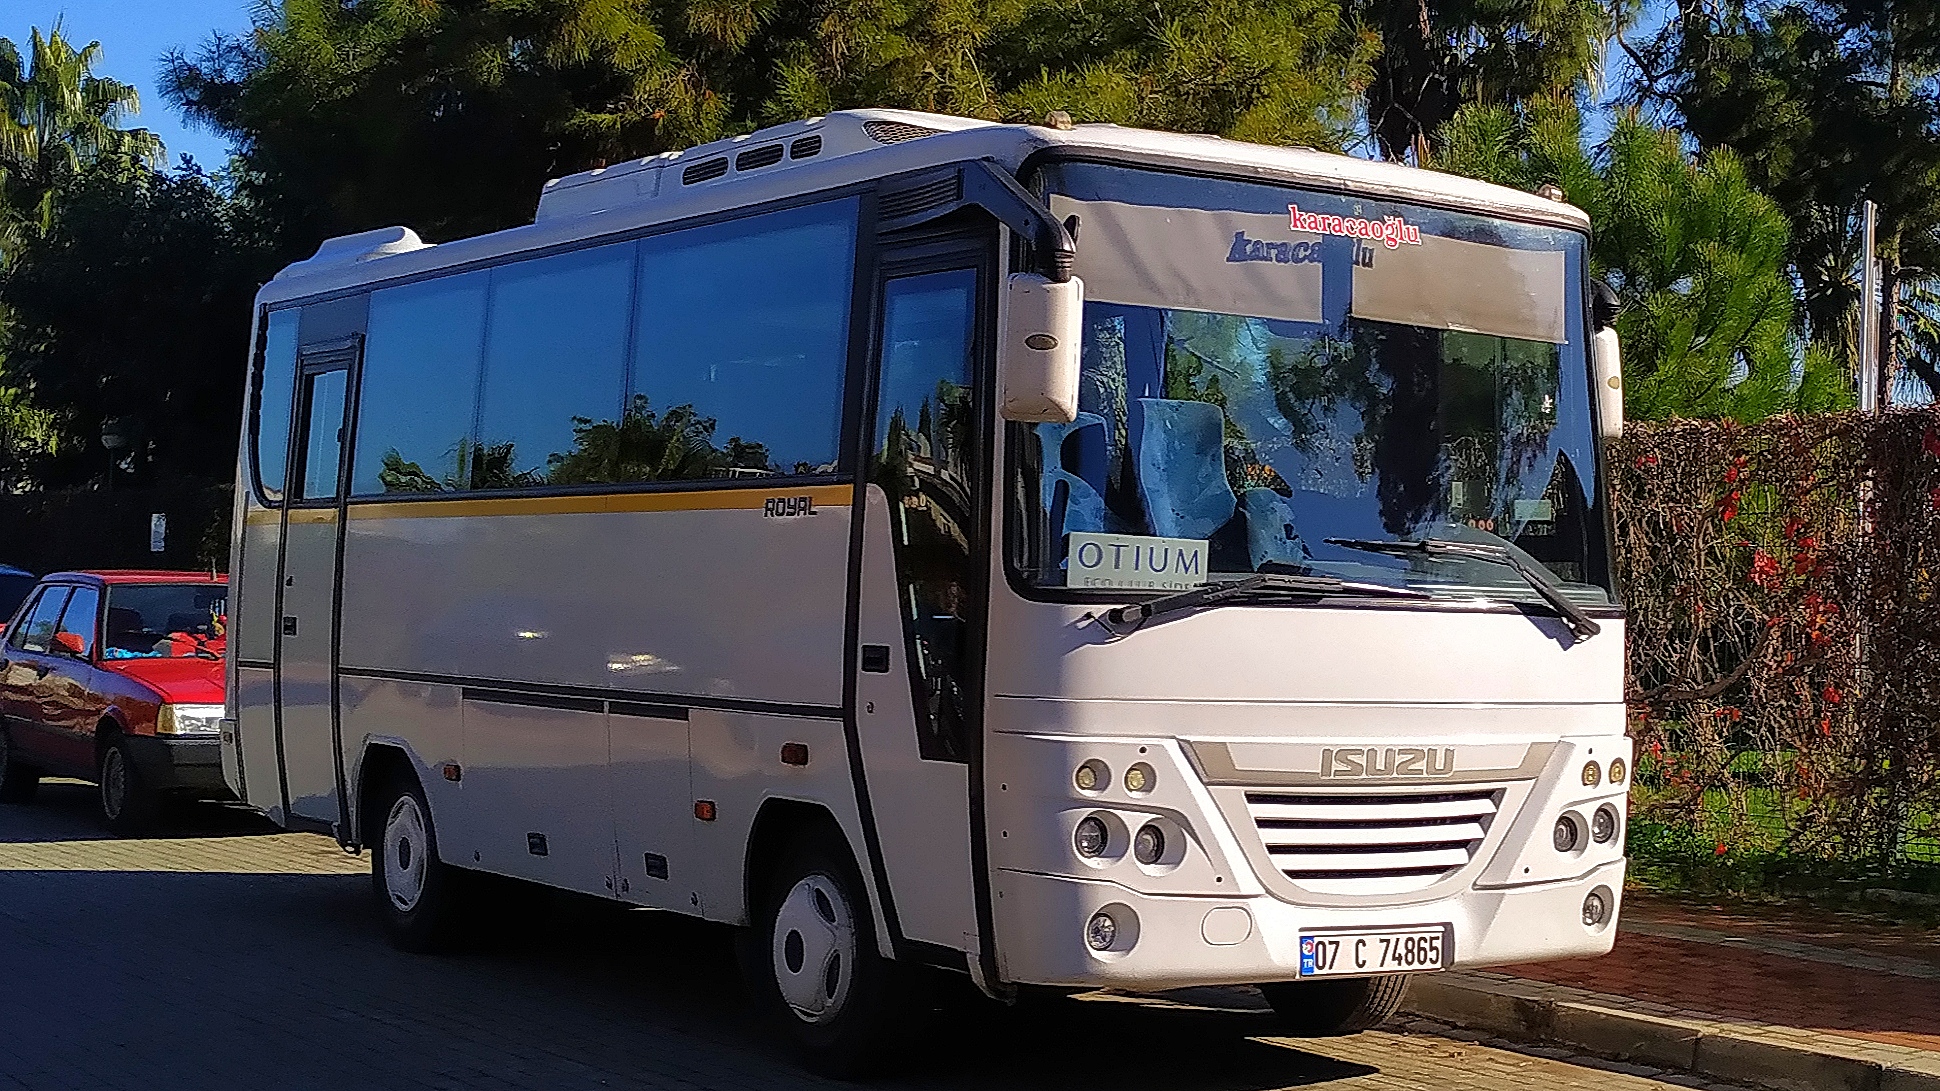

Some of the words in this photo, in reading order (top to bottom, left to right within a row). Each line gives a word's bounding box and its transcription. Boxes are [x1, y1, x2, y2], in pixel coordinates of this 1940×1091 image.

[1289, 203, 1421, 248] karacaoğlu
[763, 496, 818, 517] ROYAL
[1078, 542, 1200, 575] OTIUM
[1320, 747, 1455, 778] ISUZU
[1302, 958, 1314, 969] TR
[1315, 940, 1341, 971] 07
[1355, 938, 1367, 969] C
[1379, 935, 1440, 968] 74865
